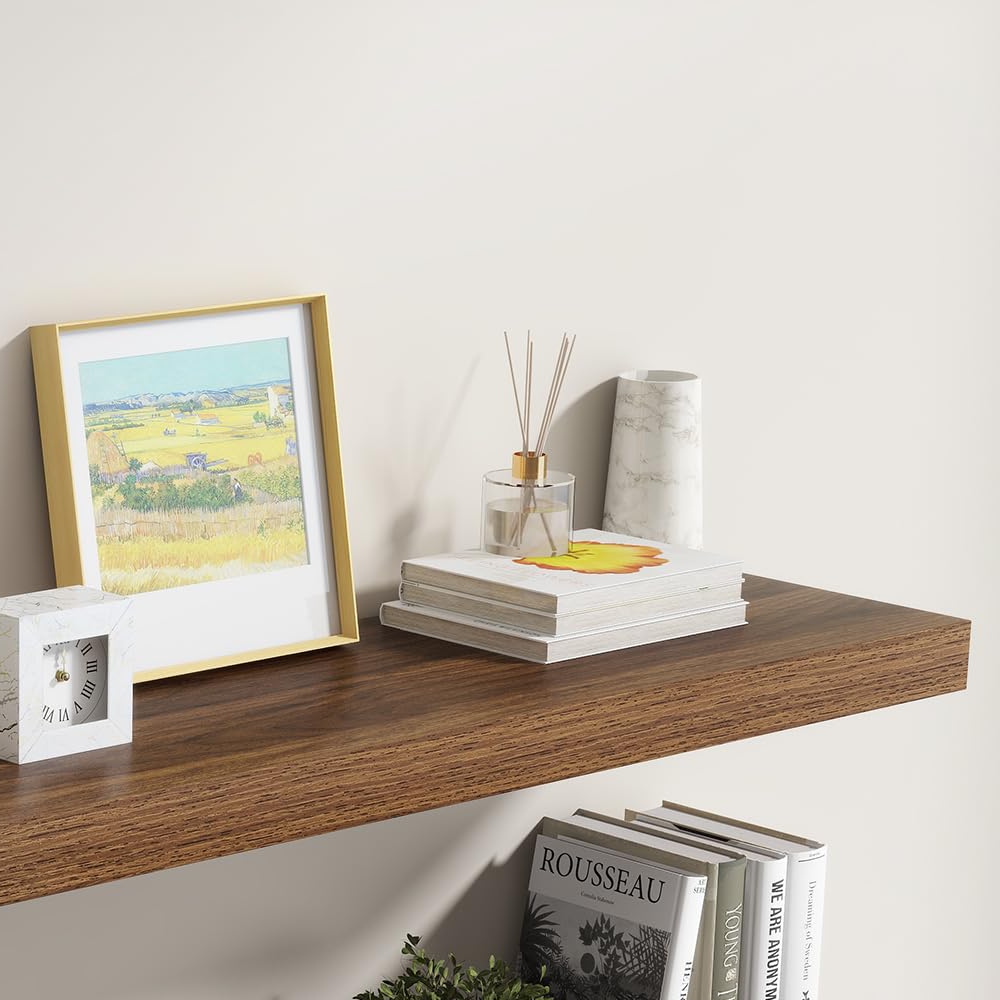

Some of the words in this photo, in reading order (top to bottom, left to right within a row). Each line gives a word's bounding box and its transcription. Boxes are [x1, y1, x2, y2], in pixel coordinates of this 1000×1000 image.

[539, 847, 666, 903] ROUSSEAU
[771, 879, 784, 903] WE
[769, 907, 782, 936] ARE
[804, 880, 816, 930] Dreaming
[723, 903, 742, 968] YOUNG
[805, 931, 813, 941] of
[802, 942, 812, 981] Sweden
